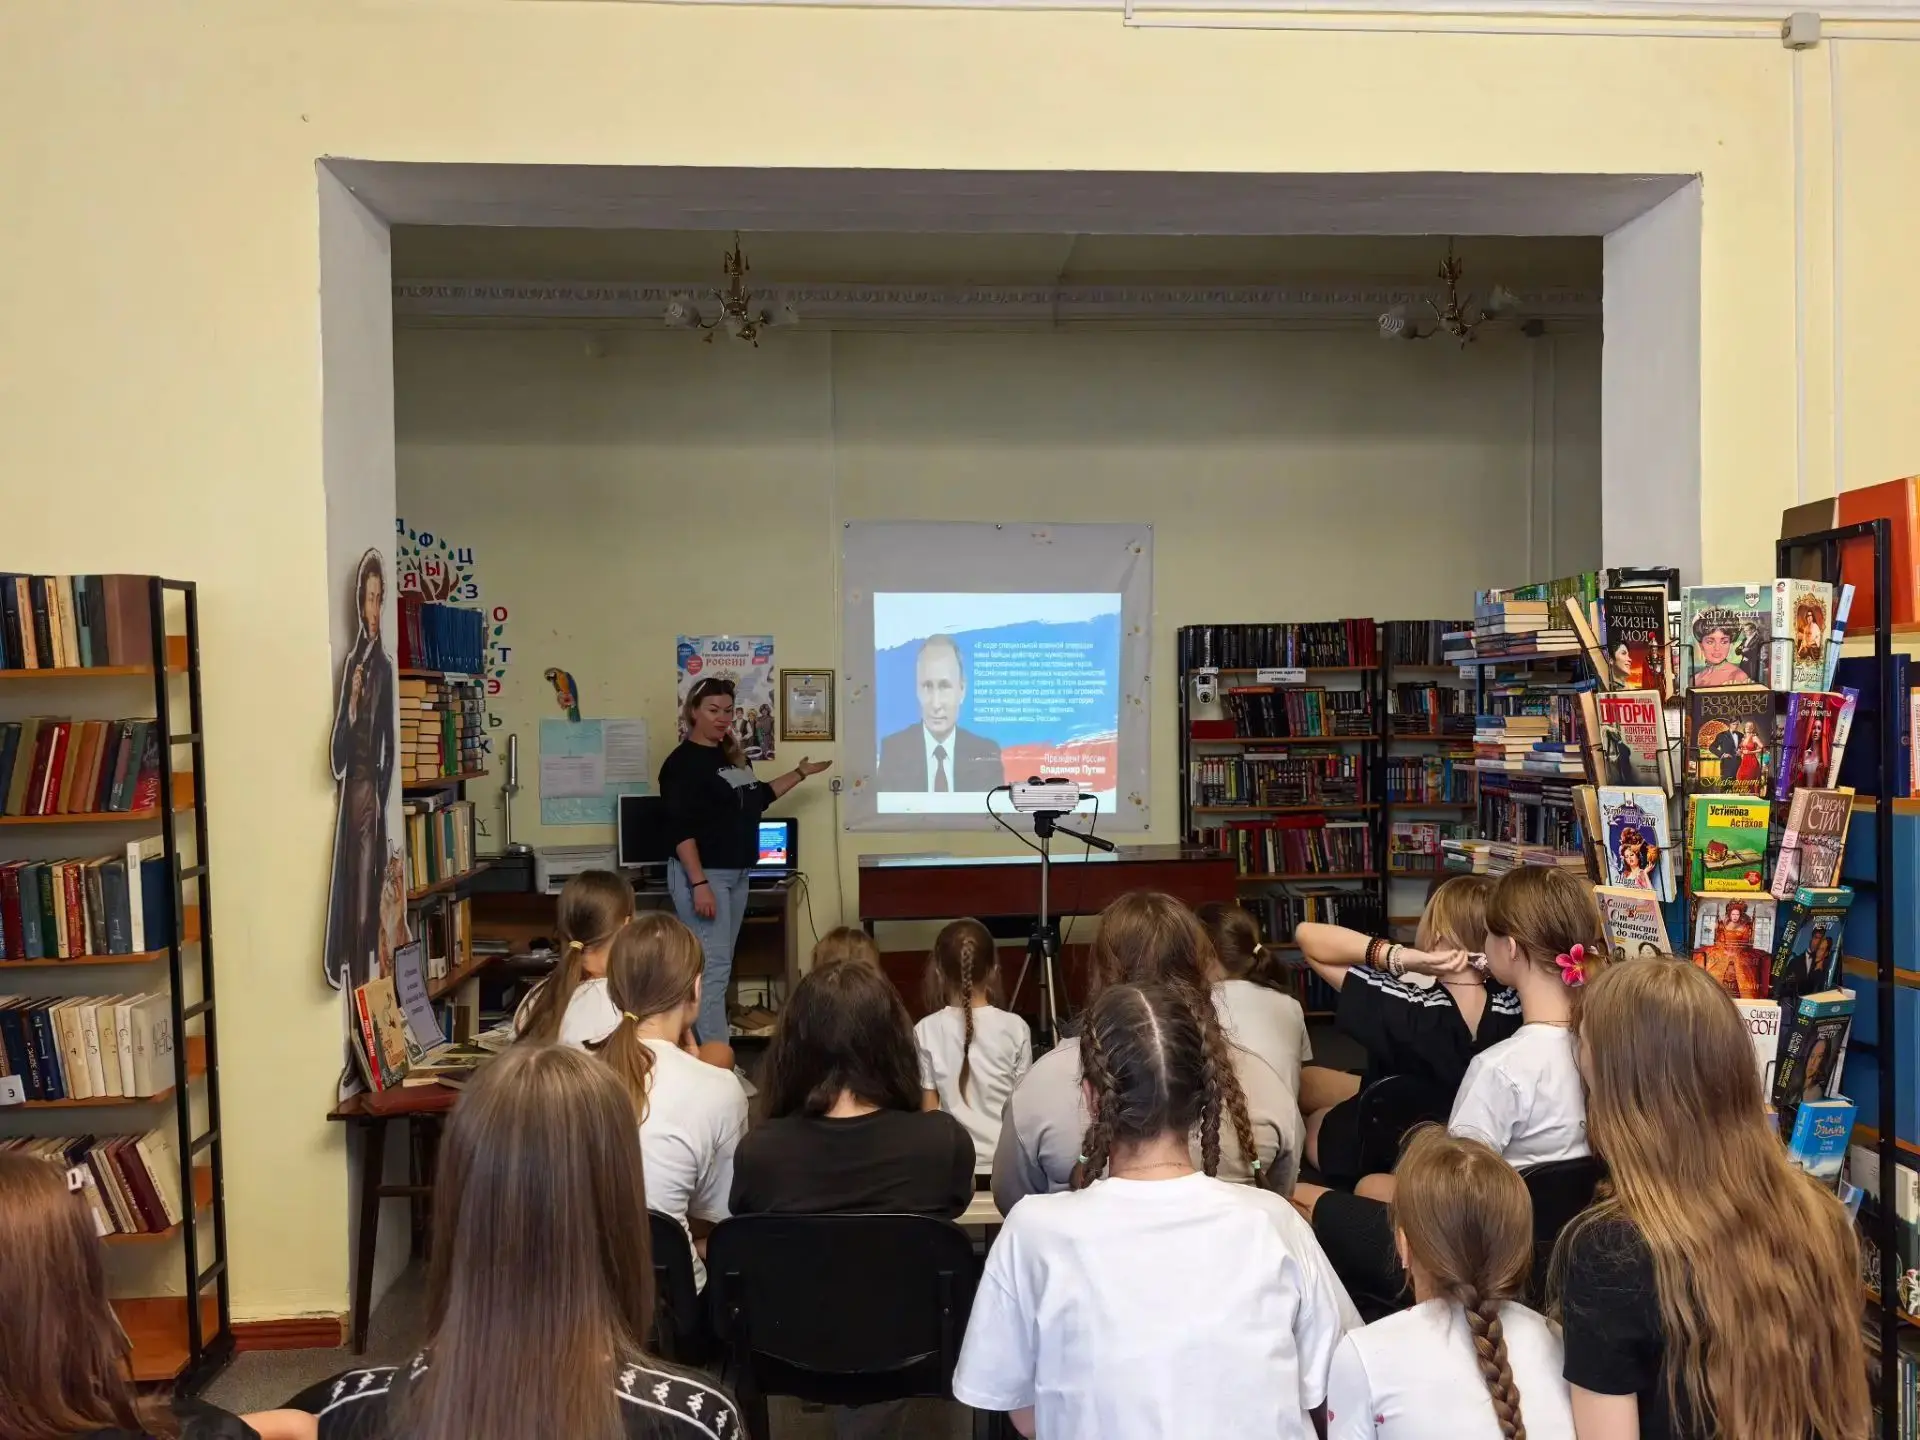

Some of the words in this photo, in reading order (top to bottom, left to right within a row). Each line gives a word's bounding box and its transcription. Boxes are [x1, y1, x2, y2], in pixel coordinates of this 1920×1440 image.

[419, 532, 433, 547] Ф
[458, 548, 473, 565] Ц
[425, 561, 440, 578] Ы
[404, 572, 417, 589] Я
[493, 606, 508, 622] О
[1696, 610, 1760, 622] Картланд
[1611, 615, 1660, 629] ЖИЗНЬ
[1621, 629, 1649, 642] МОЯ
[711, 641, 740, 652] 2026
[498, 648, 512, 663] Т
[488, 679, 501, 695] Э
[1702, 694, 1768, 708] РОЗМАРИ
[1802, 697, 1824, 708] Танец
[1600, 703, 1657, 724] ШТОРМ
[1701, 704, 1768, 717] РОДЖЕРС
[1624, 726, 1657, 736] КОНТРАКТ
[1044, 753, 1080, 764] Президент
[1082, 754, 1106, 763] России
[1040, 764, 1080, 775] Владимир
[1082, 765, 1106, 776] Путин
[1709, 805, 1750, 817] Устинова
[1730, 818, 1764, 829] Астахов
[1808, 807, 1841, 832] СТИЛ
[1610, 908, 1627, 921] От
[1627, 909, 1654, 922] Браун
[1608, 919, 1658, 935] ненависти
[1616, 929, 1627, 937] до
[1629, 931, 1659, 943] любви
[1750, 1009, 1780, 1021] СЬЮЗЕН
